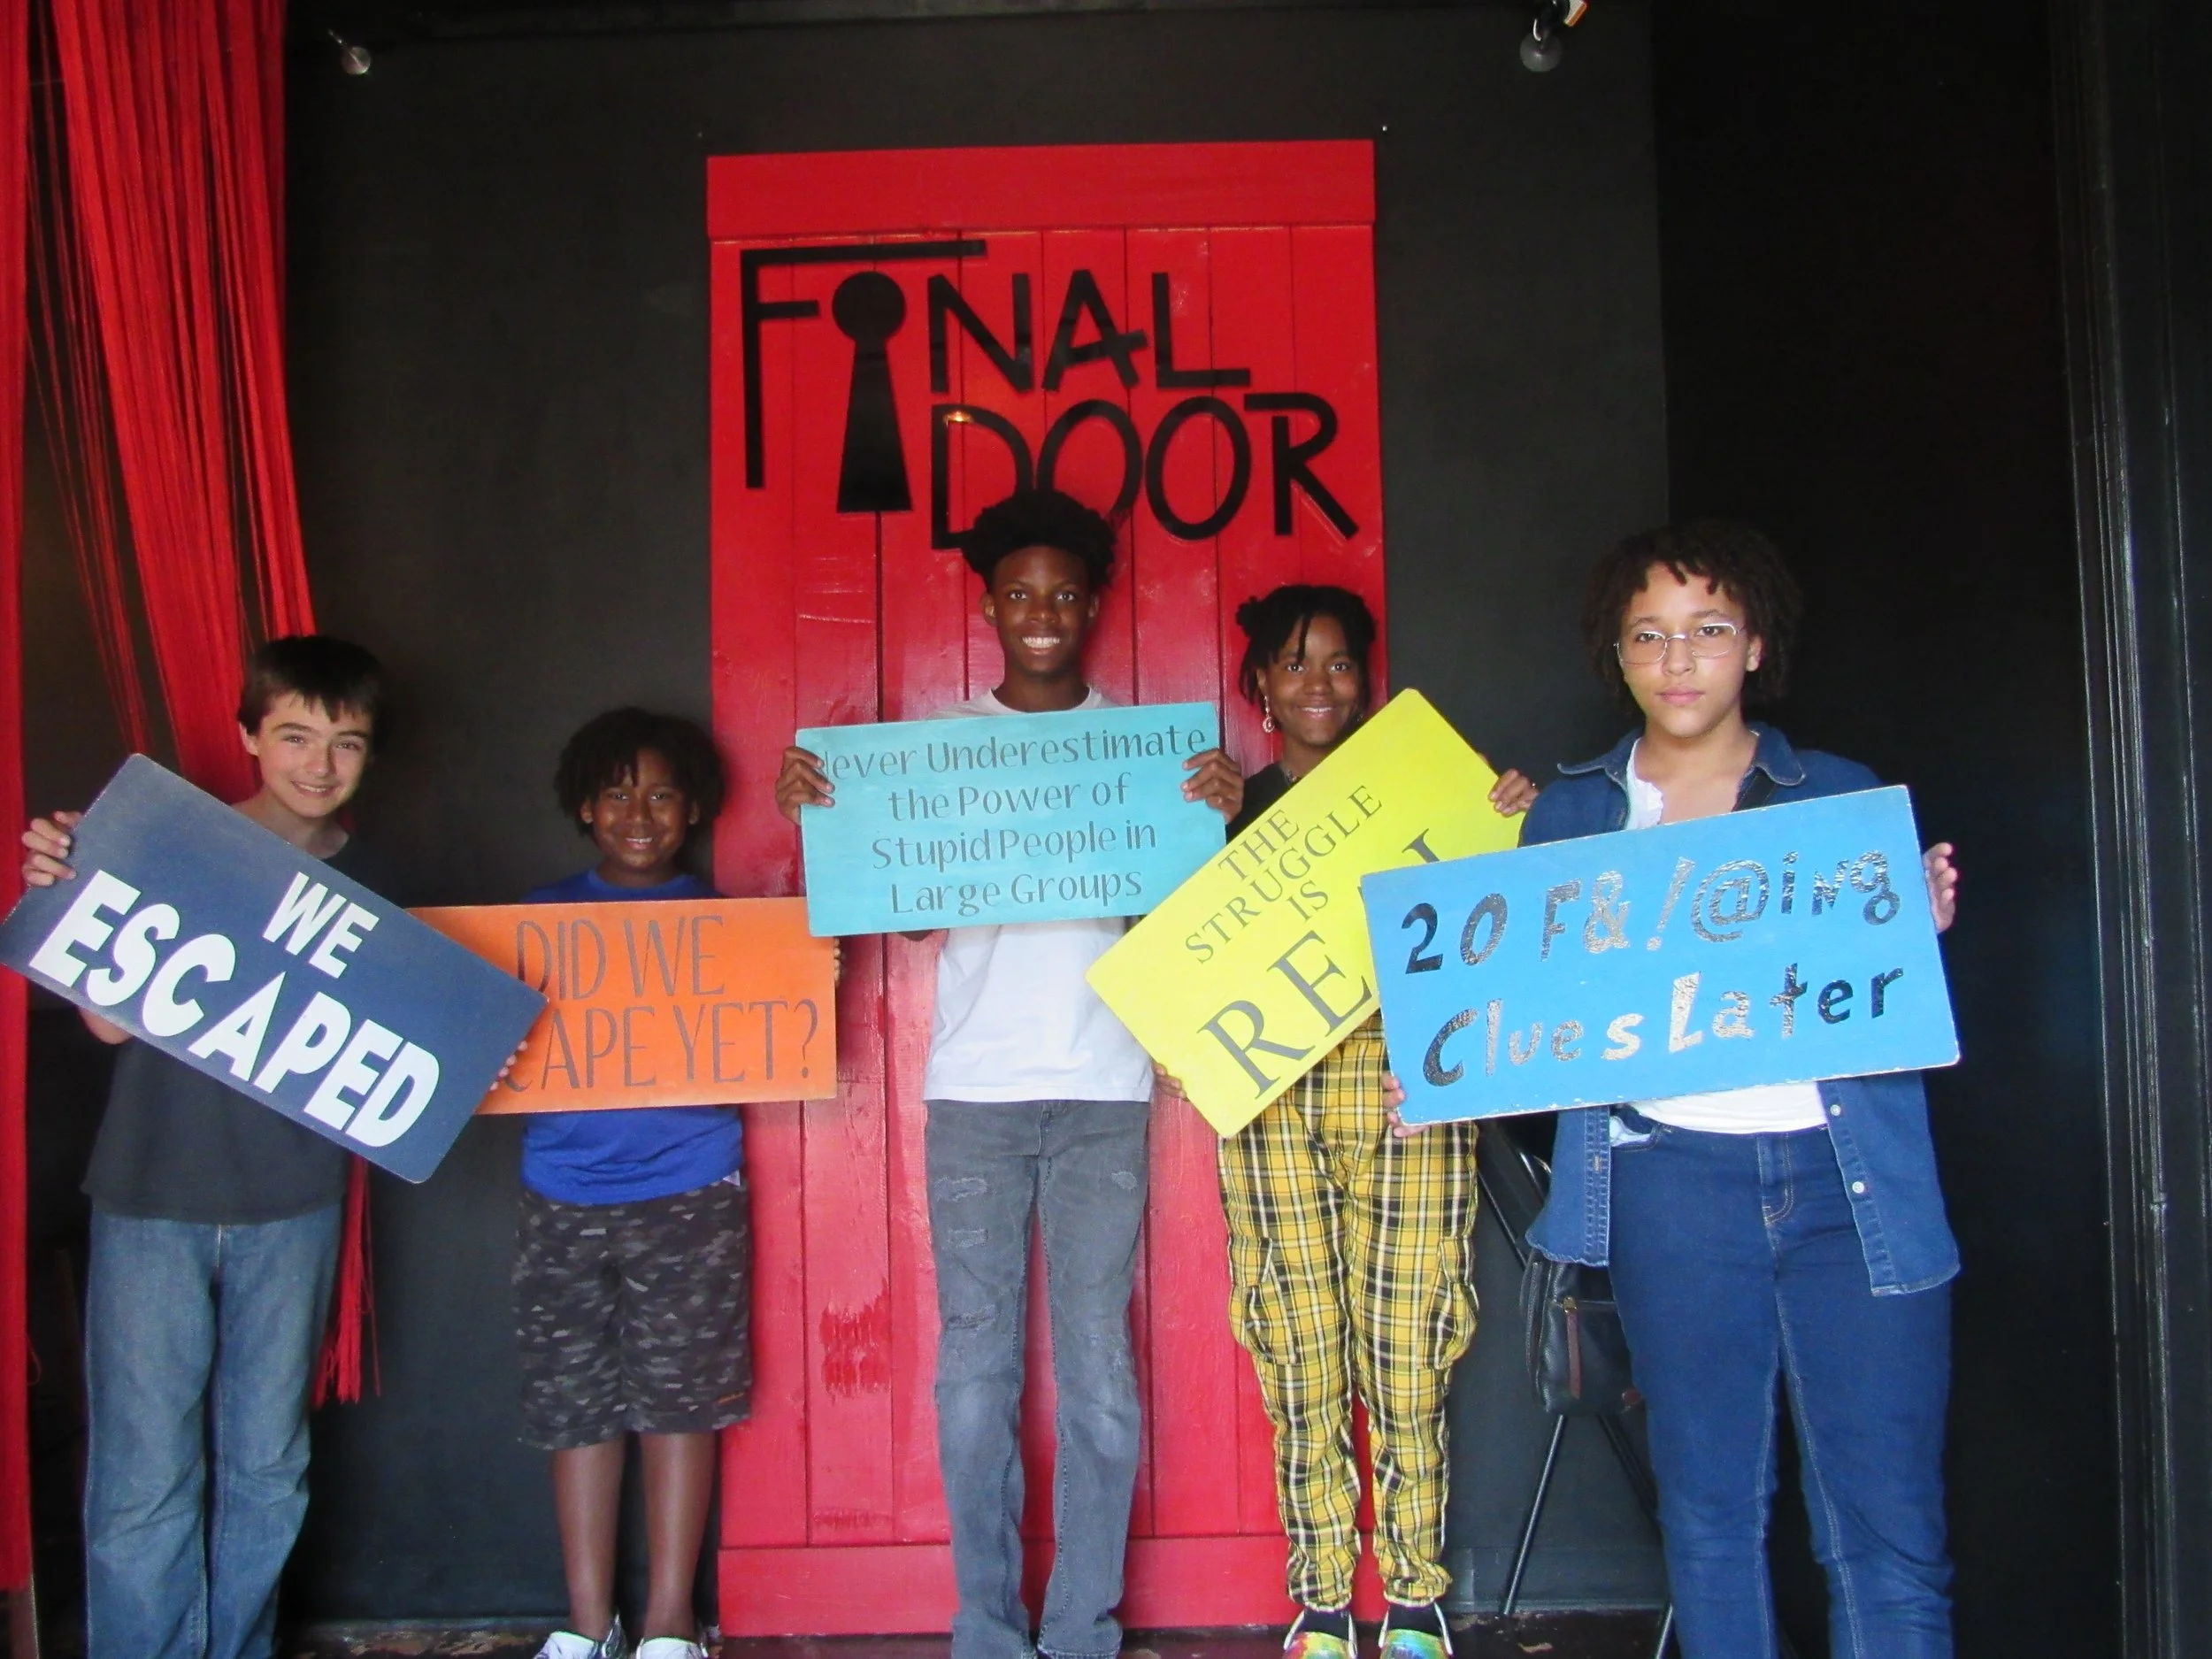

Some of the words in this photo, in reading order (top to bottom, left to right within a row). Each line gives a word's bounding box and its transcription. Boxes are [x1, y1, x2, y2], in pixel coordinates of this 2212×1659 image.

[740, 239, 1251, 513] FINAL
[931, 392, 1359, 550] DOOR
[927, 725, 1207, 773] Underestimate
[888, 787, 949, 821] the
[959, 782, 1080, 817] Power
[1092, 772, 1133, 804] of
[872, 826, 992, 872] Stupid
[1000, 821, 1118, 864] People
[1125, 819, 1156, 849] in
[1185, 784, 1383, 964] STRUGGLE
[1217, 809, 1300, 884] THE
[263, 871, 380, 979] WE
[891, 885, 1002, 918] Large
[1011, 870, 1142, 907] Groups
[1286, 880, 1329, 922] IS
[1401, 892, 1508, 974] 20
[516, 918, 607, 1001] DID
[624, 914, 726, 997] WE
[1196, 828, 1440, 1100] RE
[28, 870, 441, 1148] ESCAPED
[673, 998, 818, 1082] YET?
[1422, 997, 1643, 1087] Clues
[1669, 962, 1904, 1055] Later
